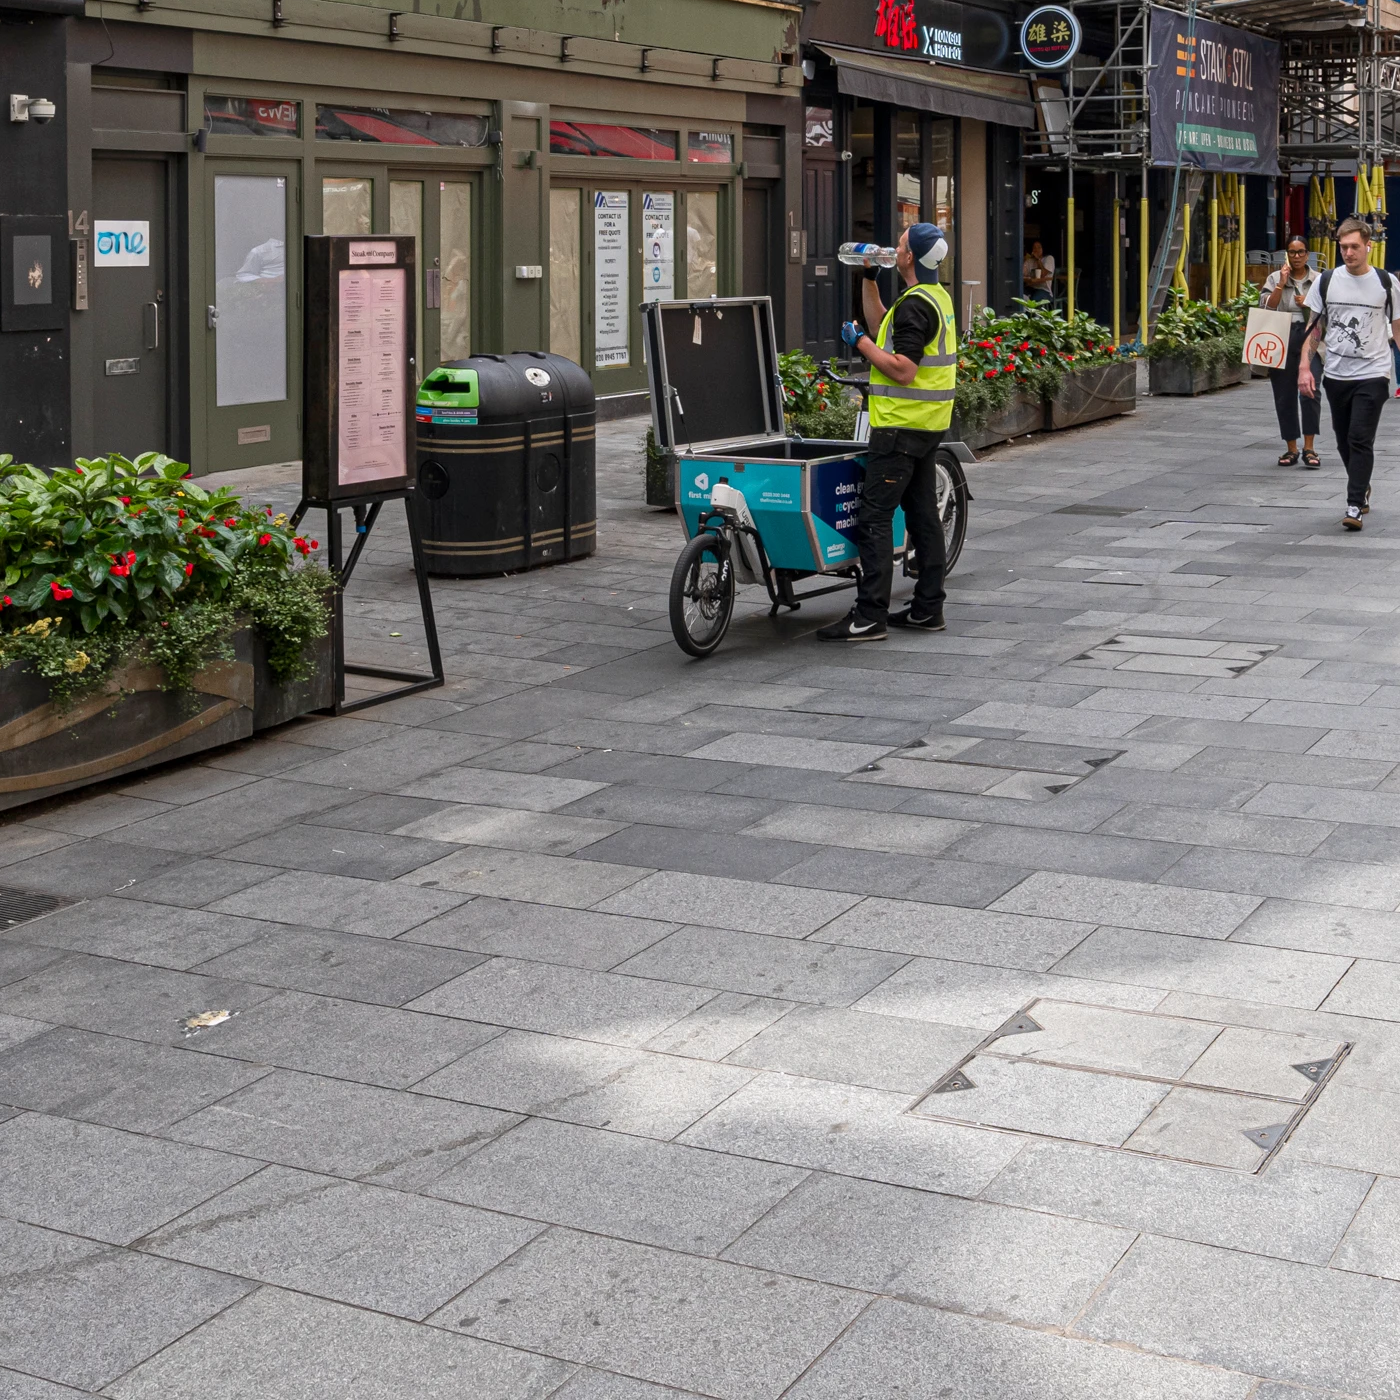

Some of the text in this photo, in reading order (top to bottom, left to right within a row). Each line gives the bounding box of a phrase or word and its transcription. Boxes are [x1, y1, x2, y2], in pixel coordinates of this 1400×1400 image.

[1200, 39, 1227, 85] STACK
[68, 210, 90, 235] 14
[97, 232, 147, 255] one
[373, 250, 395, 258] Company
[688, 491, 701, 499] first
[835, 482, 857, 496] clean,
